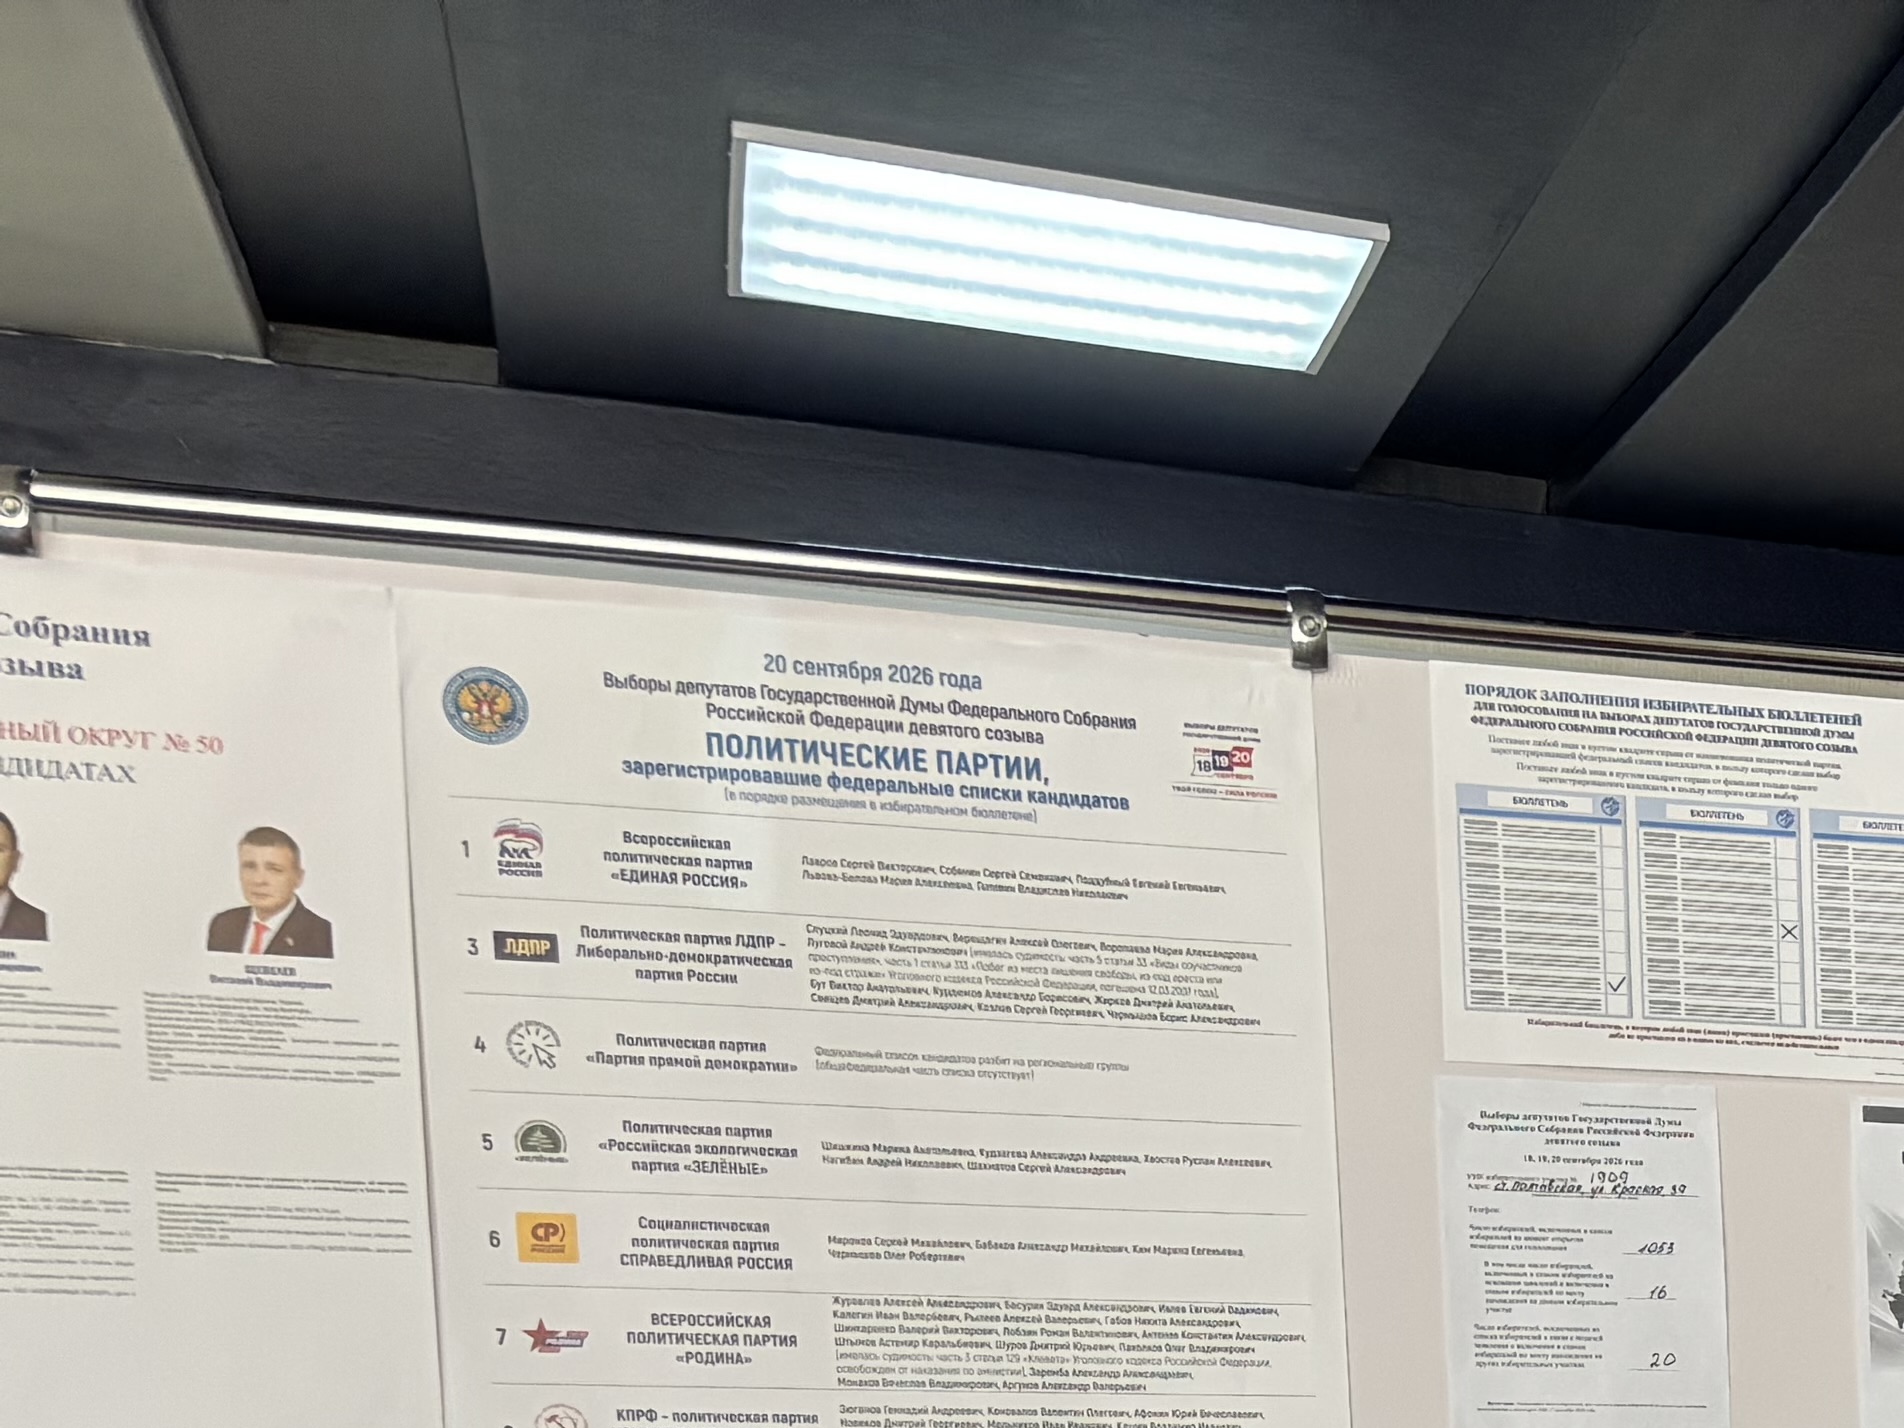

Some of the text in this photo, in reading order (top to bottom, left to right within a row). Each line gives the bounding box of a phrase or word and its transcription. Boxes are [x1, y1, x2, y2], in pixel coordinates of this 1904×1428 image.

[0, 611, 151, 648] Собрания
[0, 657, 85, 681] зыва
[763, 653, 983, 692] 20 сентября 2026 года
[602, 671, 1137, 730] Выборы депутатов Государственной Думы Федерального Собрания
[1464, 683, 1863, 726] ПОРЯДОК ЗАПОЛНЕНИЯ ИЗБИРАТЕЛЬНЫХ БЮЛЛЕТЕНЕЙ
[705, 702, 1045, 745] Российской Федерации девятого созыва
[67, 725, 156, 751] ОКРУГ
[196, 735, 224, 755] 50
[705, 732, 1049, 785] ПОЛИТИЧЕСКИЕ ПАРТИИ,
[1231, 751, 1251, 763] 20
[0, 756, 137, 784] ДИДАТАХ
[621, 760, 1130, 810] зарегистрировавшие федеральные списки кандидатов
[461, 840, 470, 858] 1
[622, 831, 732, 850] Всероссийская
[602, 851, 753, 872] политическая партия
[610, 868, 748, 889] «ЕДИНАЯ РОССИЯ»
[580, 925, 775, 949] Политическая партия ЛДПР
[466, 938, 479, 956] 3
[503, 939, 551, 956] ЛДПР
[635, 968, 738, 984] партия России
[474, 1035, 487, 1053] 4
[615, 1033, 767, 1054] Политическая партия
[585, 1051, 798, 1073] «Партия прямой демократии»
[622, 1120, 773, 1140] Политическая партия
[481, 1133, 493, 1151] 5
[598, 1138, 798, 1160] «Российская экологическая
[631, 1158, 769, 1175] партия «ЗЕЛЁНЫЕ»
[1590, 1170, 1630, 1184] 1909
[638, 1216, 770, 1233] Социалистическая
[488, 1230, 501, 1249] 6
[631, 1237, 780, 1253] политическая партия
[619, 1253, 793, 1271] СПРАВЕДЛИВАЯ РОССИЯ
[1649, 1284, 1668, 1300] 16
[650, 1312, 772, 1328] ВСЕРОССИЙСКАЯ
[494, 1327, 507, 1346] 7
[626, 1331, 798, 1348] ПОЛИТИЧЕСКАЯ ПАРТИЯ
[675, 1351, 753, 1366] «РОДИНА»
[1650, 1352, 1677, 1369] 20
[616, 1408, 819, 1427] КПРФ политическая партия
